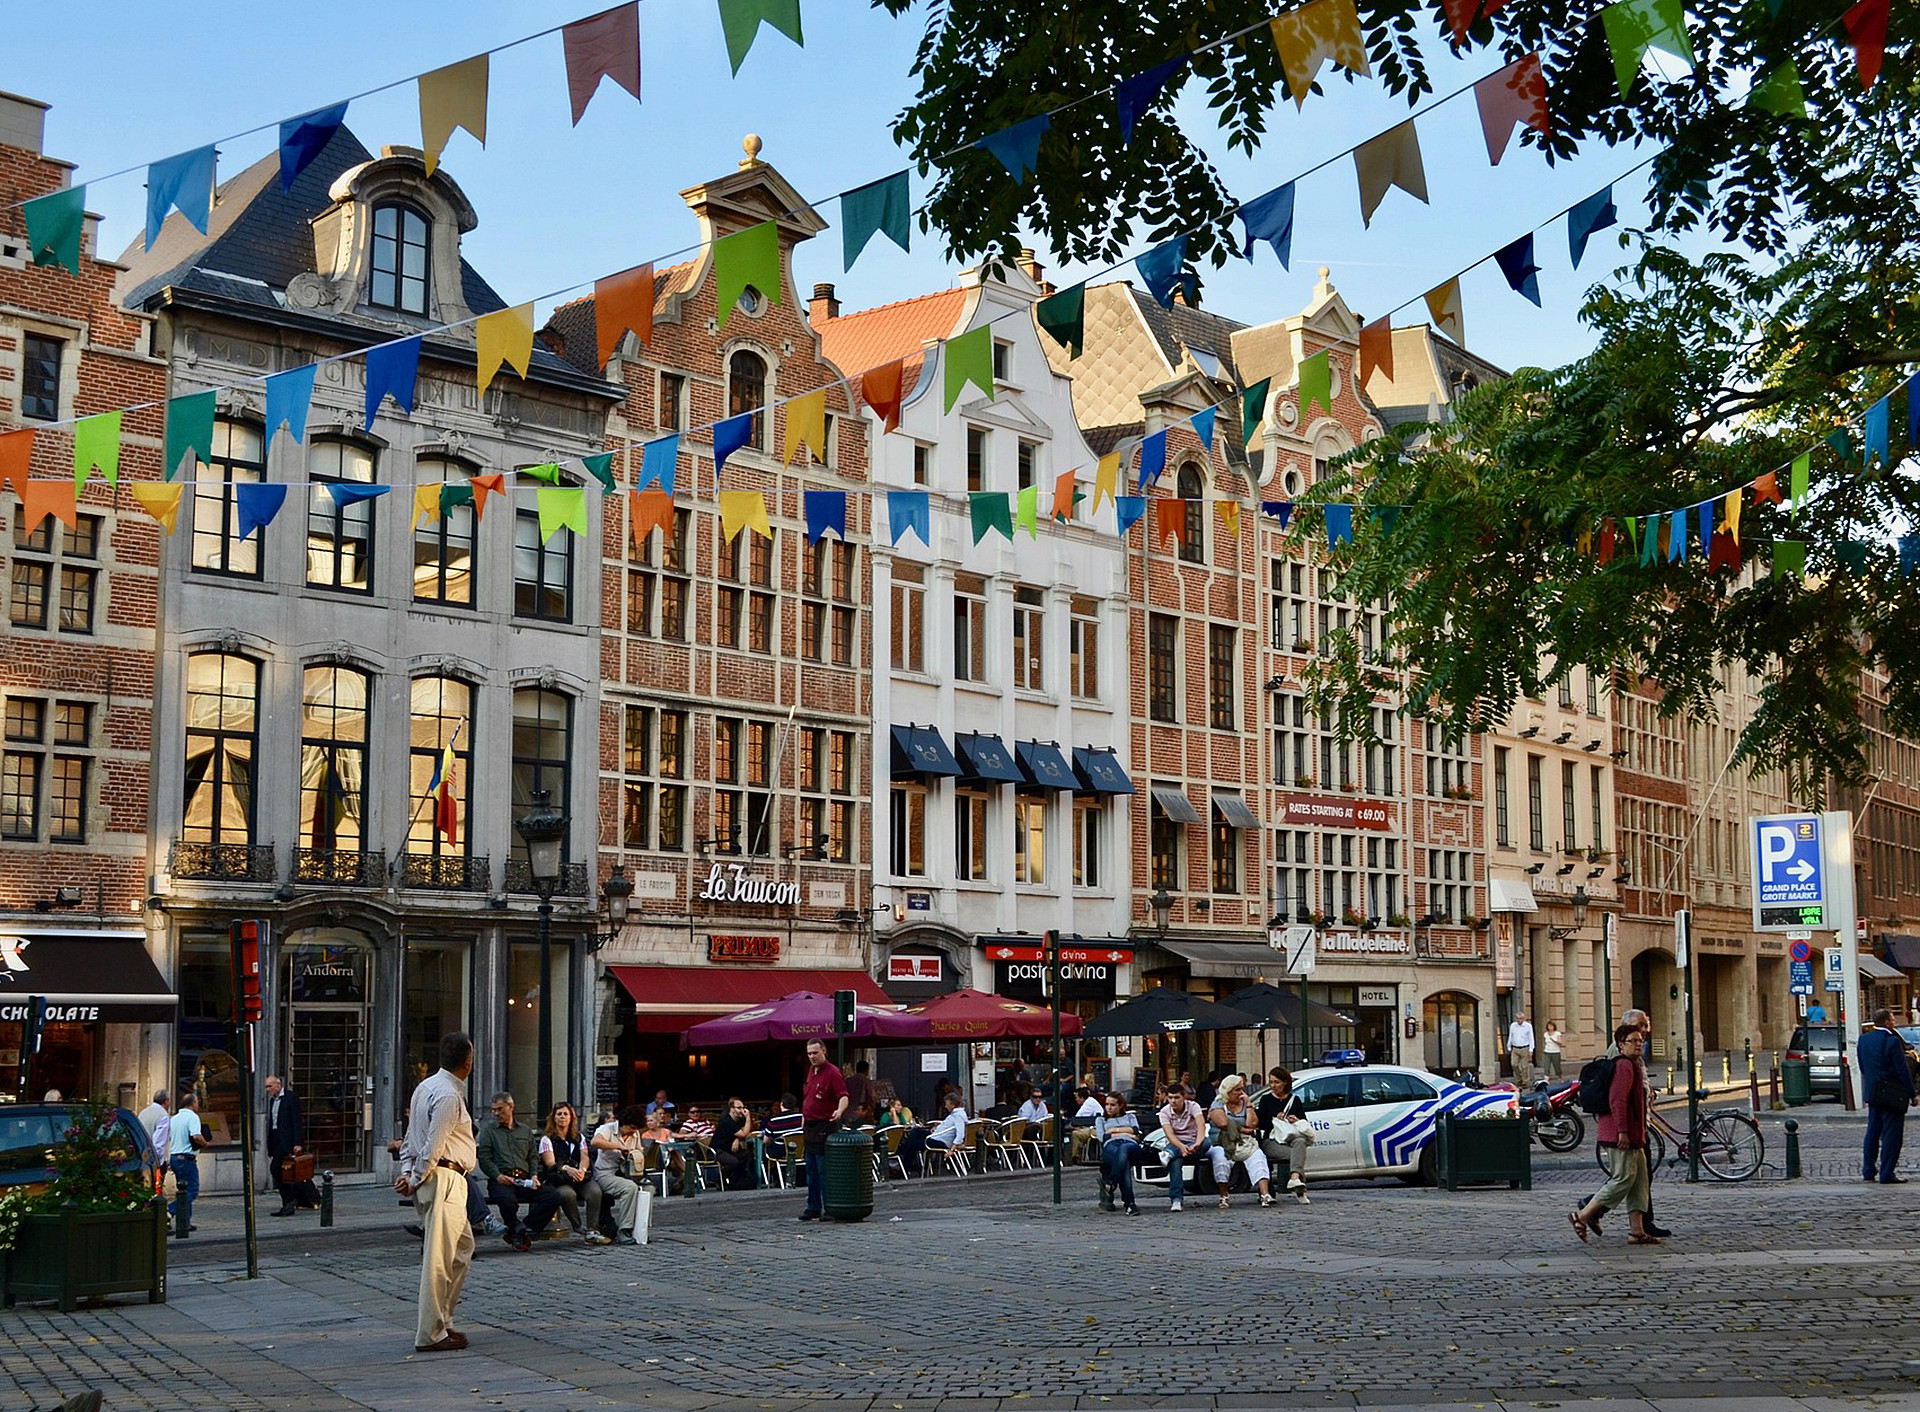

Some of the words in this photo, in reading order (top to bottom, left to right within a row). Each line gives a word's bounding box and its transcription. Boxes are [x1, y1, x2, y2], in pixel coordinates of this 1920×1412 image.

[1288, 802, 1311, 815] RATES
[1311, 804, 1344, 818] STARTING
[1344, 807, 1354, 818] AT
[1760, 825, 1796, 882] P
[727, 863, 803, 905] Faucon
[1761, 884, 1790, 893] GRAND
[1790, 883, 1816, 892] PLACE
[1761, 892, 1787, 901] GROTE
[1787, 891, 1818, 900] MARKT
[1798, 907, 1822, 916] LIBRE
[711, 935, 781, 956] PRIMUS
[302, 964, 354, 977] Andorra
[1361, 991, 1390, 1001] HOTEL
[0, 1006, 100, 1021] CHOLATE
[791, 1023, 820, 1035] Keizer
[964, 1020, 988, 1033] Quint
